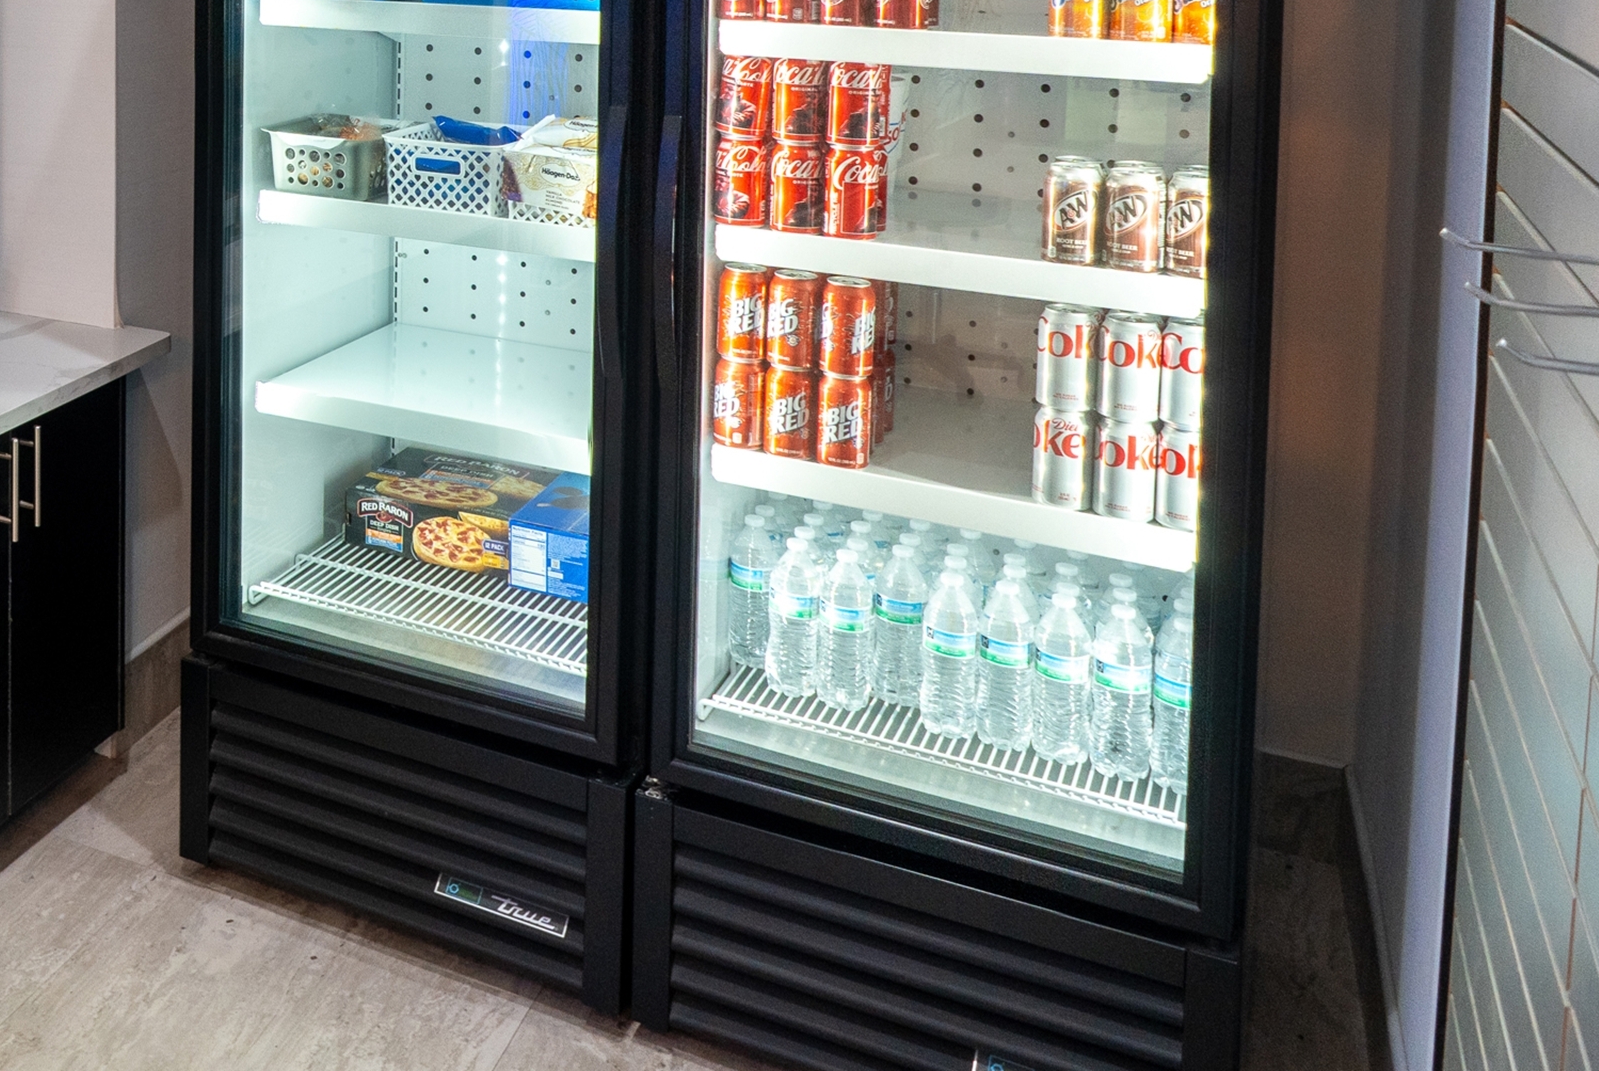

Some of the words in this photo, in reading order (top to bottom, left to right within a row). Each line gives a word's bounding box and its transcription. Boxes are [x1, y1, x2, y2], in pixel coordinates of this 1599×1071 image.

[733, 294, 763, 316] BIG
[768, 299, 794, 318] BIG
[729, 309, 765, 336] RED
[775, 393, 806, 418] BIG
[828, 401, 860, 427] BIG
[772, 408, 810, 435] RED
[826, 418, 863, 444] RED
[434, 456, 463, 465] RED
[468, 459, 520, 475] BARON
[361, 501, 378, 511] RED
[378, 502, 409, 522] BARON
[370, 519, 384, 527] DEEP
[491, 894, 555, 929] true
